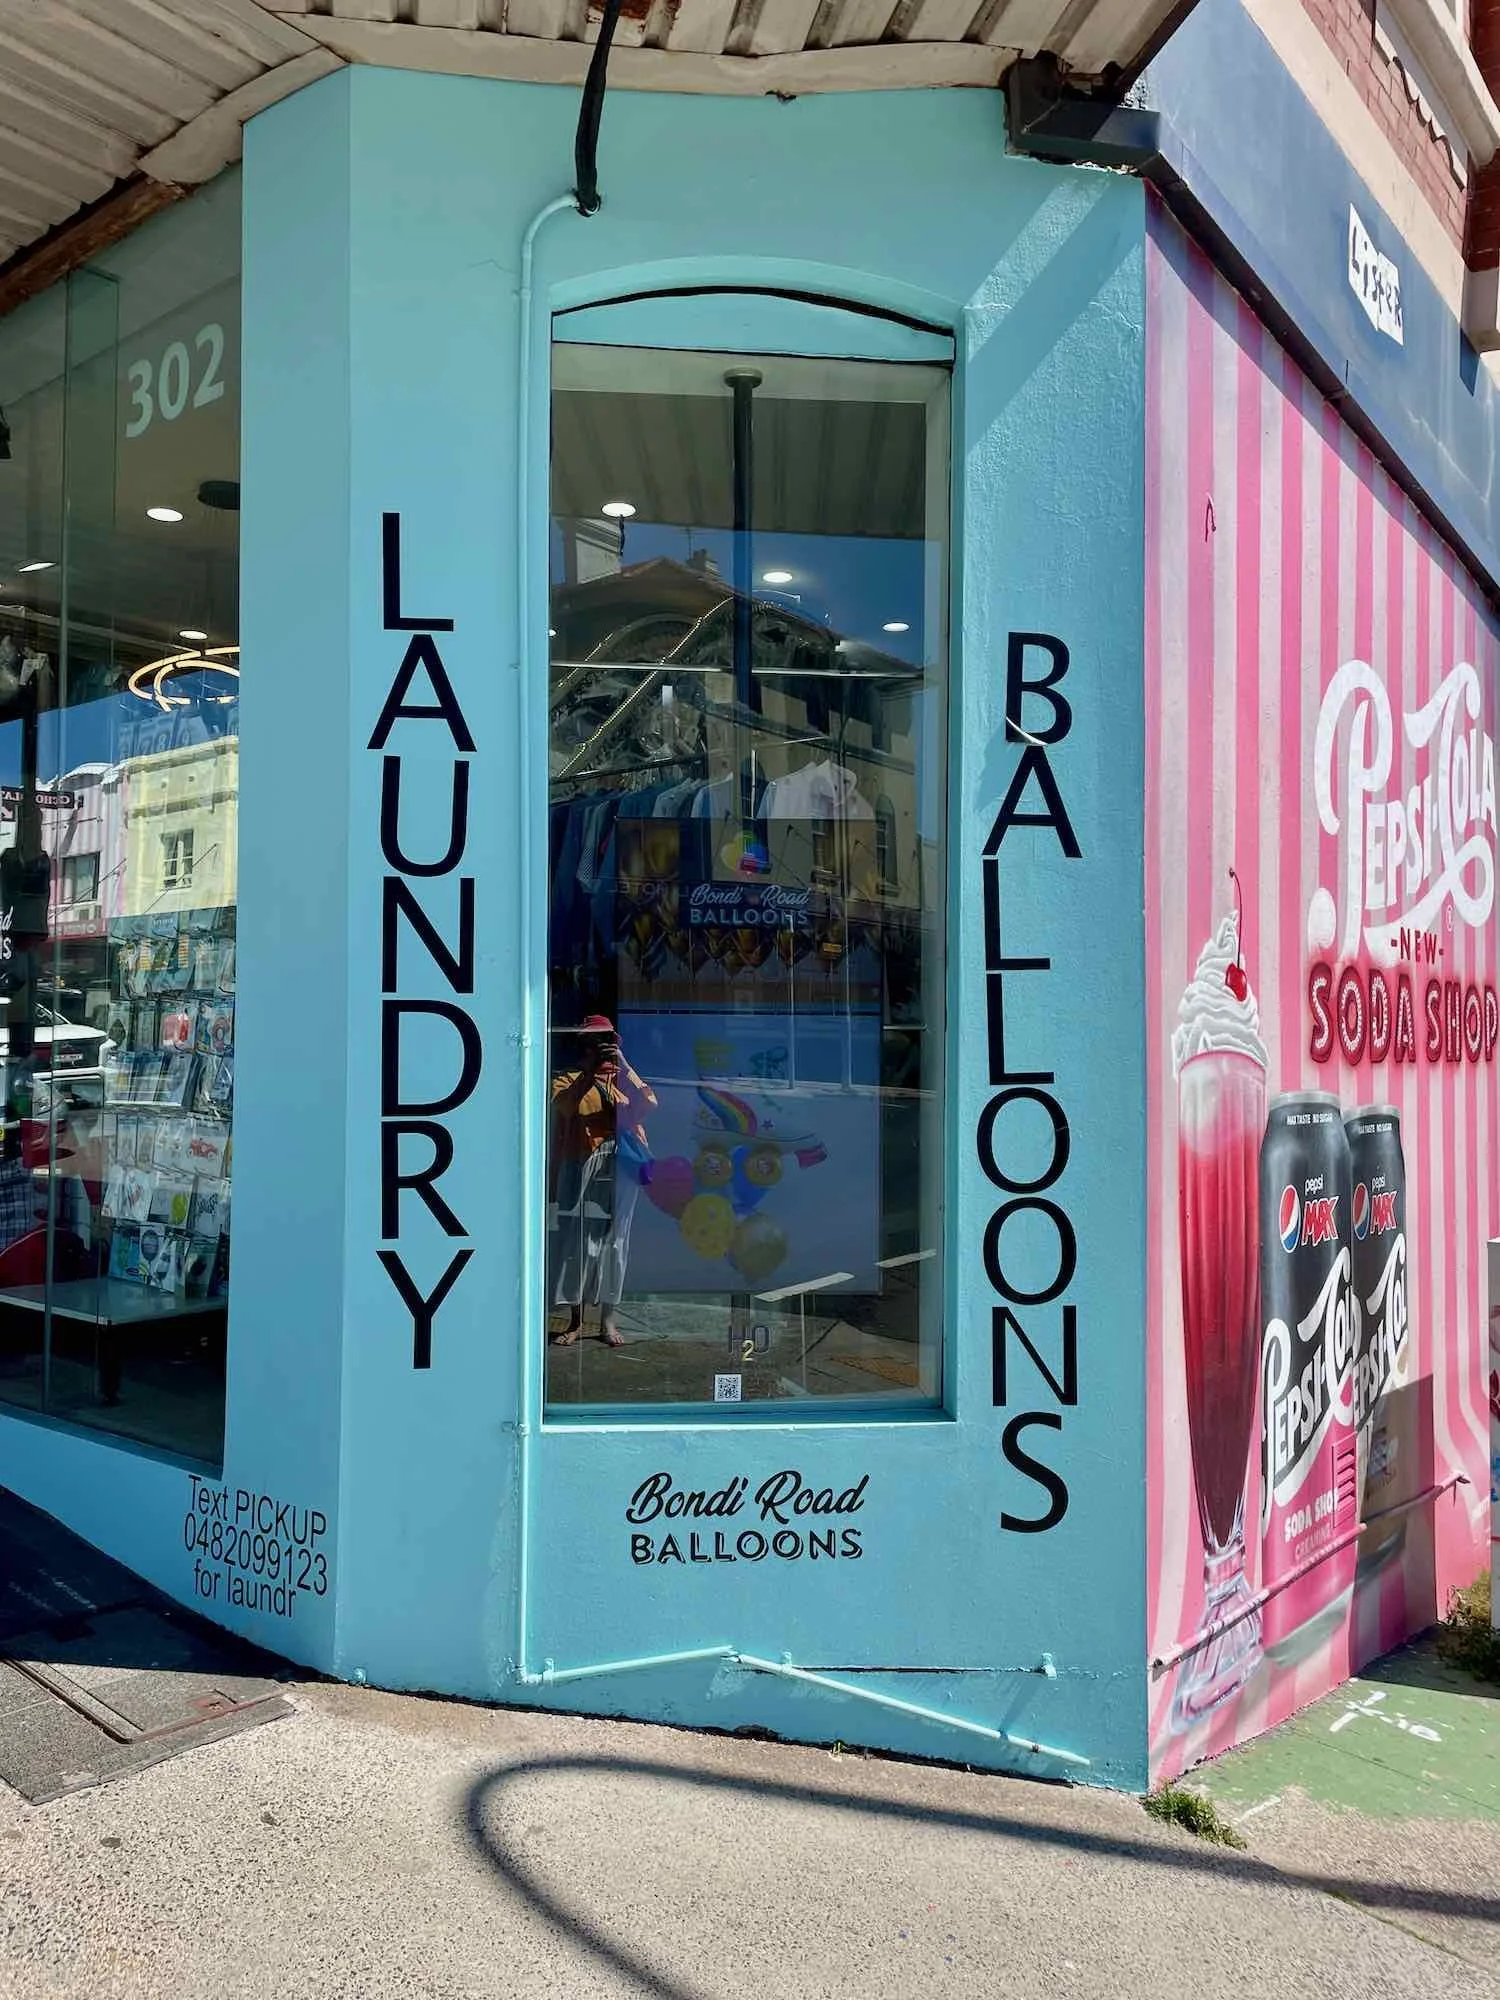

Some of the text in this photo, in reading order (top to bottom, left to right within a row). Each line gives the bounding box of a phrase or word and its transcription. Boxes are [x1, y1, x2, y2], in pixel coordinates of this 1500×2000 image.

[126, 323, 225, 438] 302
[689, 883, 744, 906] Bondi
[760, 883, 812, 908] Road
[690, 909, 808, 925] BALLOONS
[367, 512, 482, 1369] LAUNDRY
[1308, 962, 1498, 1065] SODA SHOP
[977, 632, 1082, 1533] BALLOONS
[1305, 1174, 1324, 1195] pepsi
[1372, 1174, 1385, 1192] pepsi
[1302, 1196, 1339, 1246] MAX
[1370, 1191, 1397, 1235] MAX
[188, 1474, 326, 1548] Text PICKUP
[626, 1470, 870, 1525] Bondi Road
[1285, 1503, 1312, 1544] SODA
[184, 1512, 327, 1596] 0482099123
[631, 1529, 864, 1565] BALLOONS
[194, 1558, 297, 1618] for laundr
